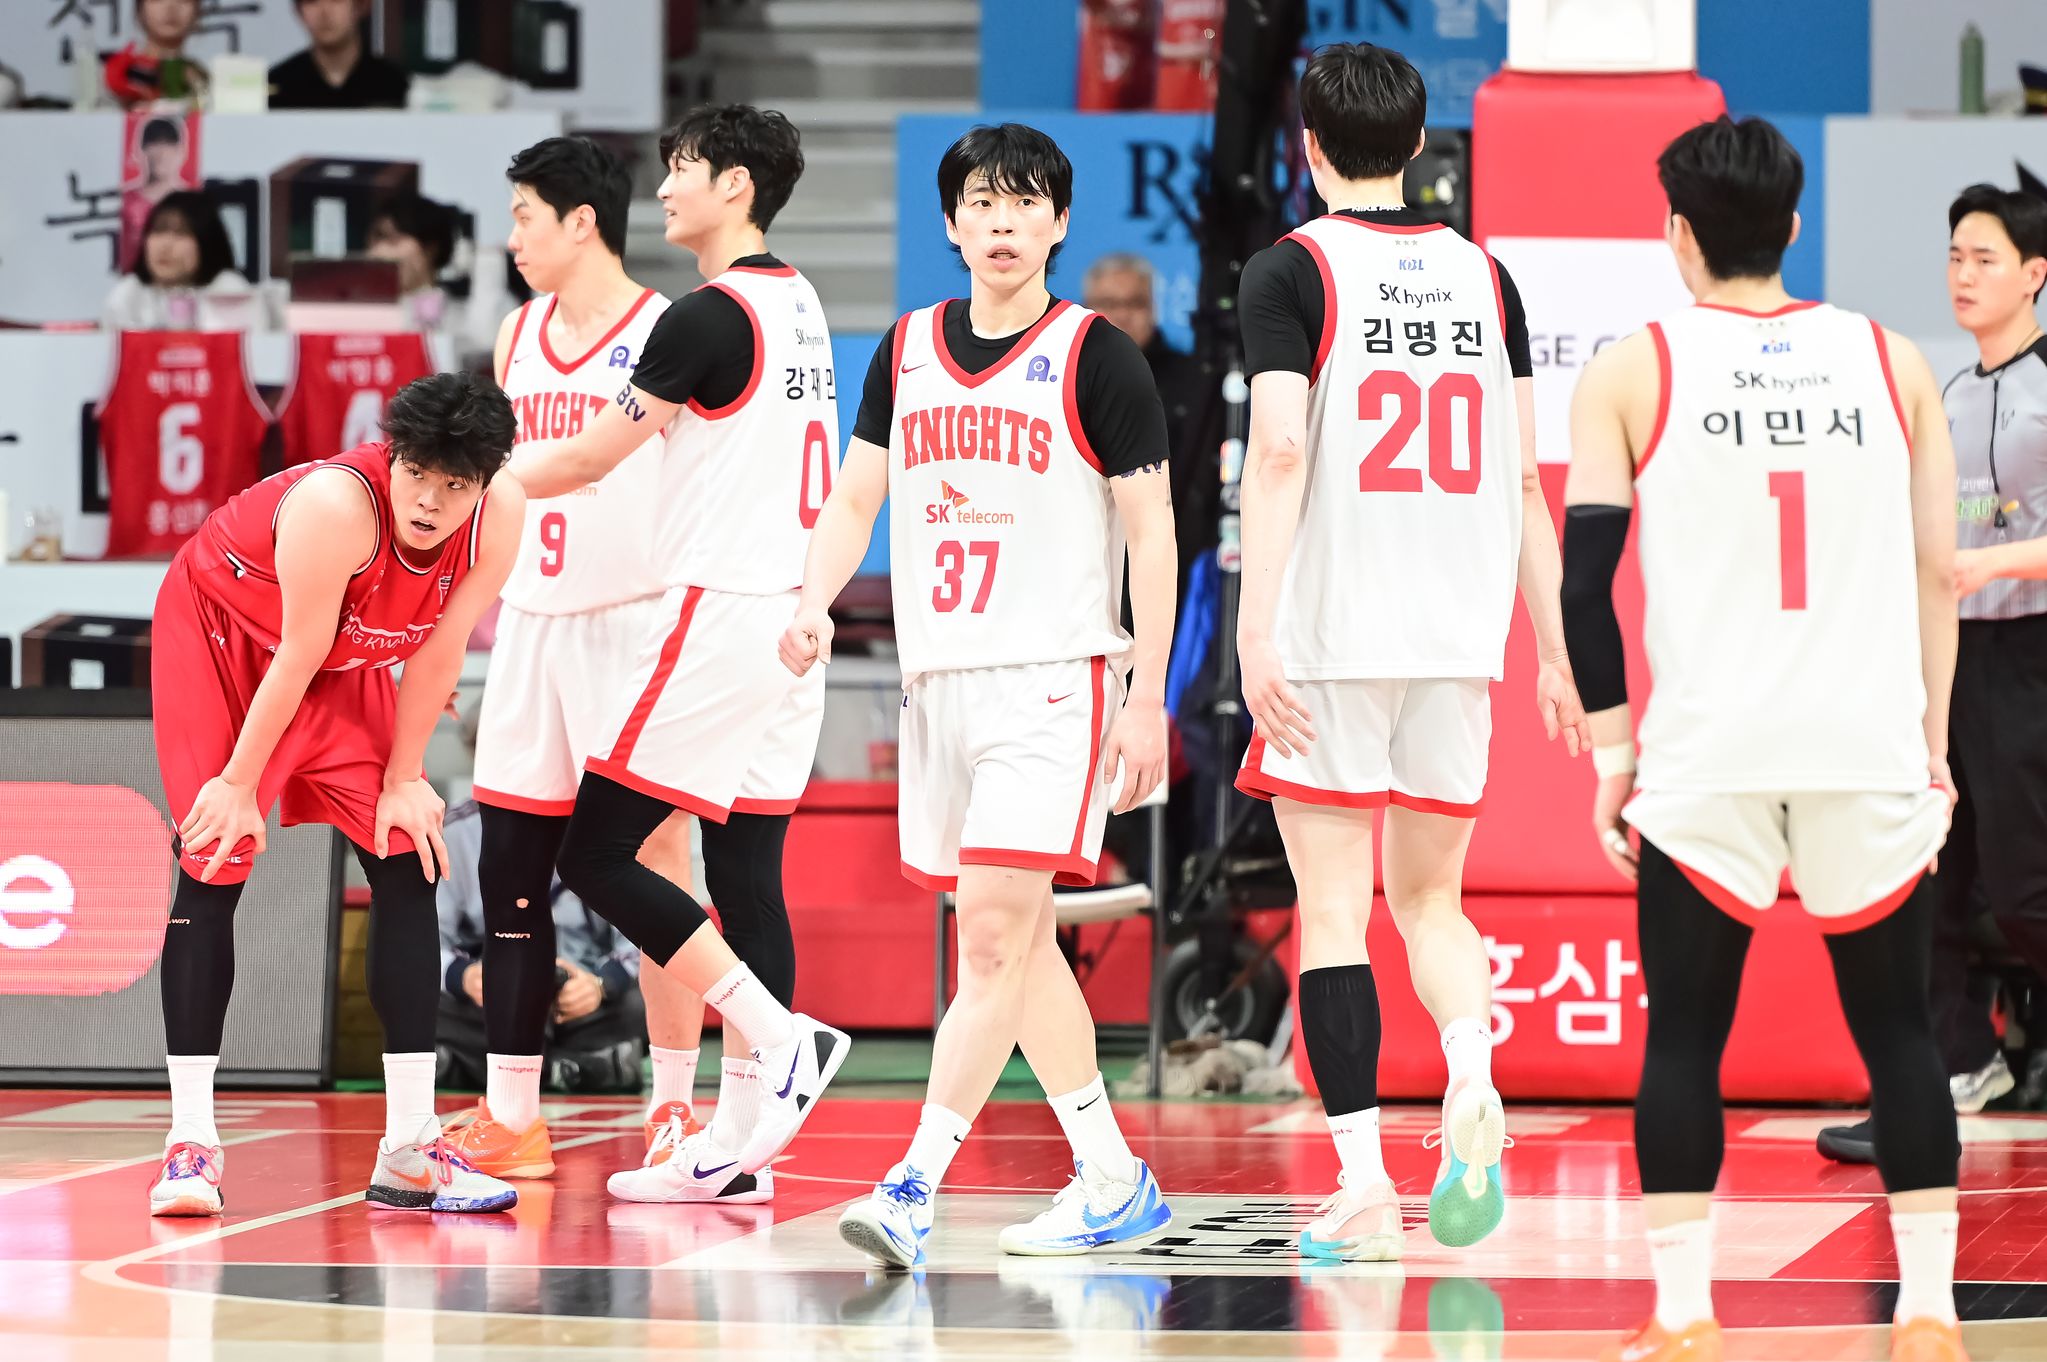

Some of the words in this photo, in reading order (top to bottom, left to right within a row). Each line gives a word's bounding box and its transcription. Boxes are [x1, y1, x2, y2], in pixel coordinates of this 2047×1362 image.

[1379, 283, 1401, 304] SK
[1404, 288, 1453, 309] hynix
[1363, 318, 1483, 357] 김명진
[1734, 371, 1767, 389] SK
[1771, 373, 1831, 394] hynix
[158, 402, 204, 496] 6
[901, 405, 1052, 475] KNIGHTS
[1358, 369, 1483, 495] 20
[1703, 408, 1863, 447] 이민서
[540, 512, 567, 577] 9
[926, 504, 950, 524] SK
[957, 508, 1014, 525] telecom
[1768, 471, 1807, 611] 1
[931, 540, 1000, 614] 37
